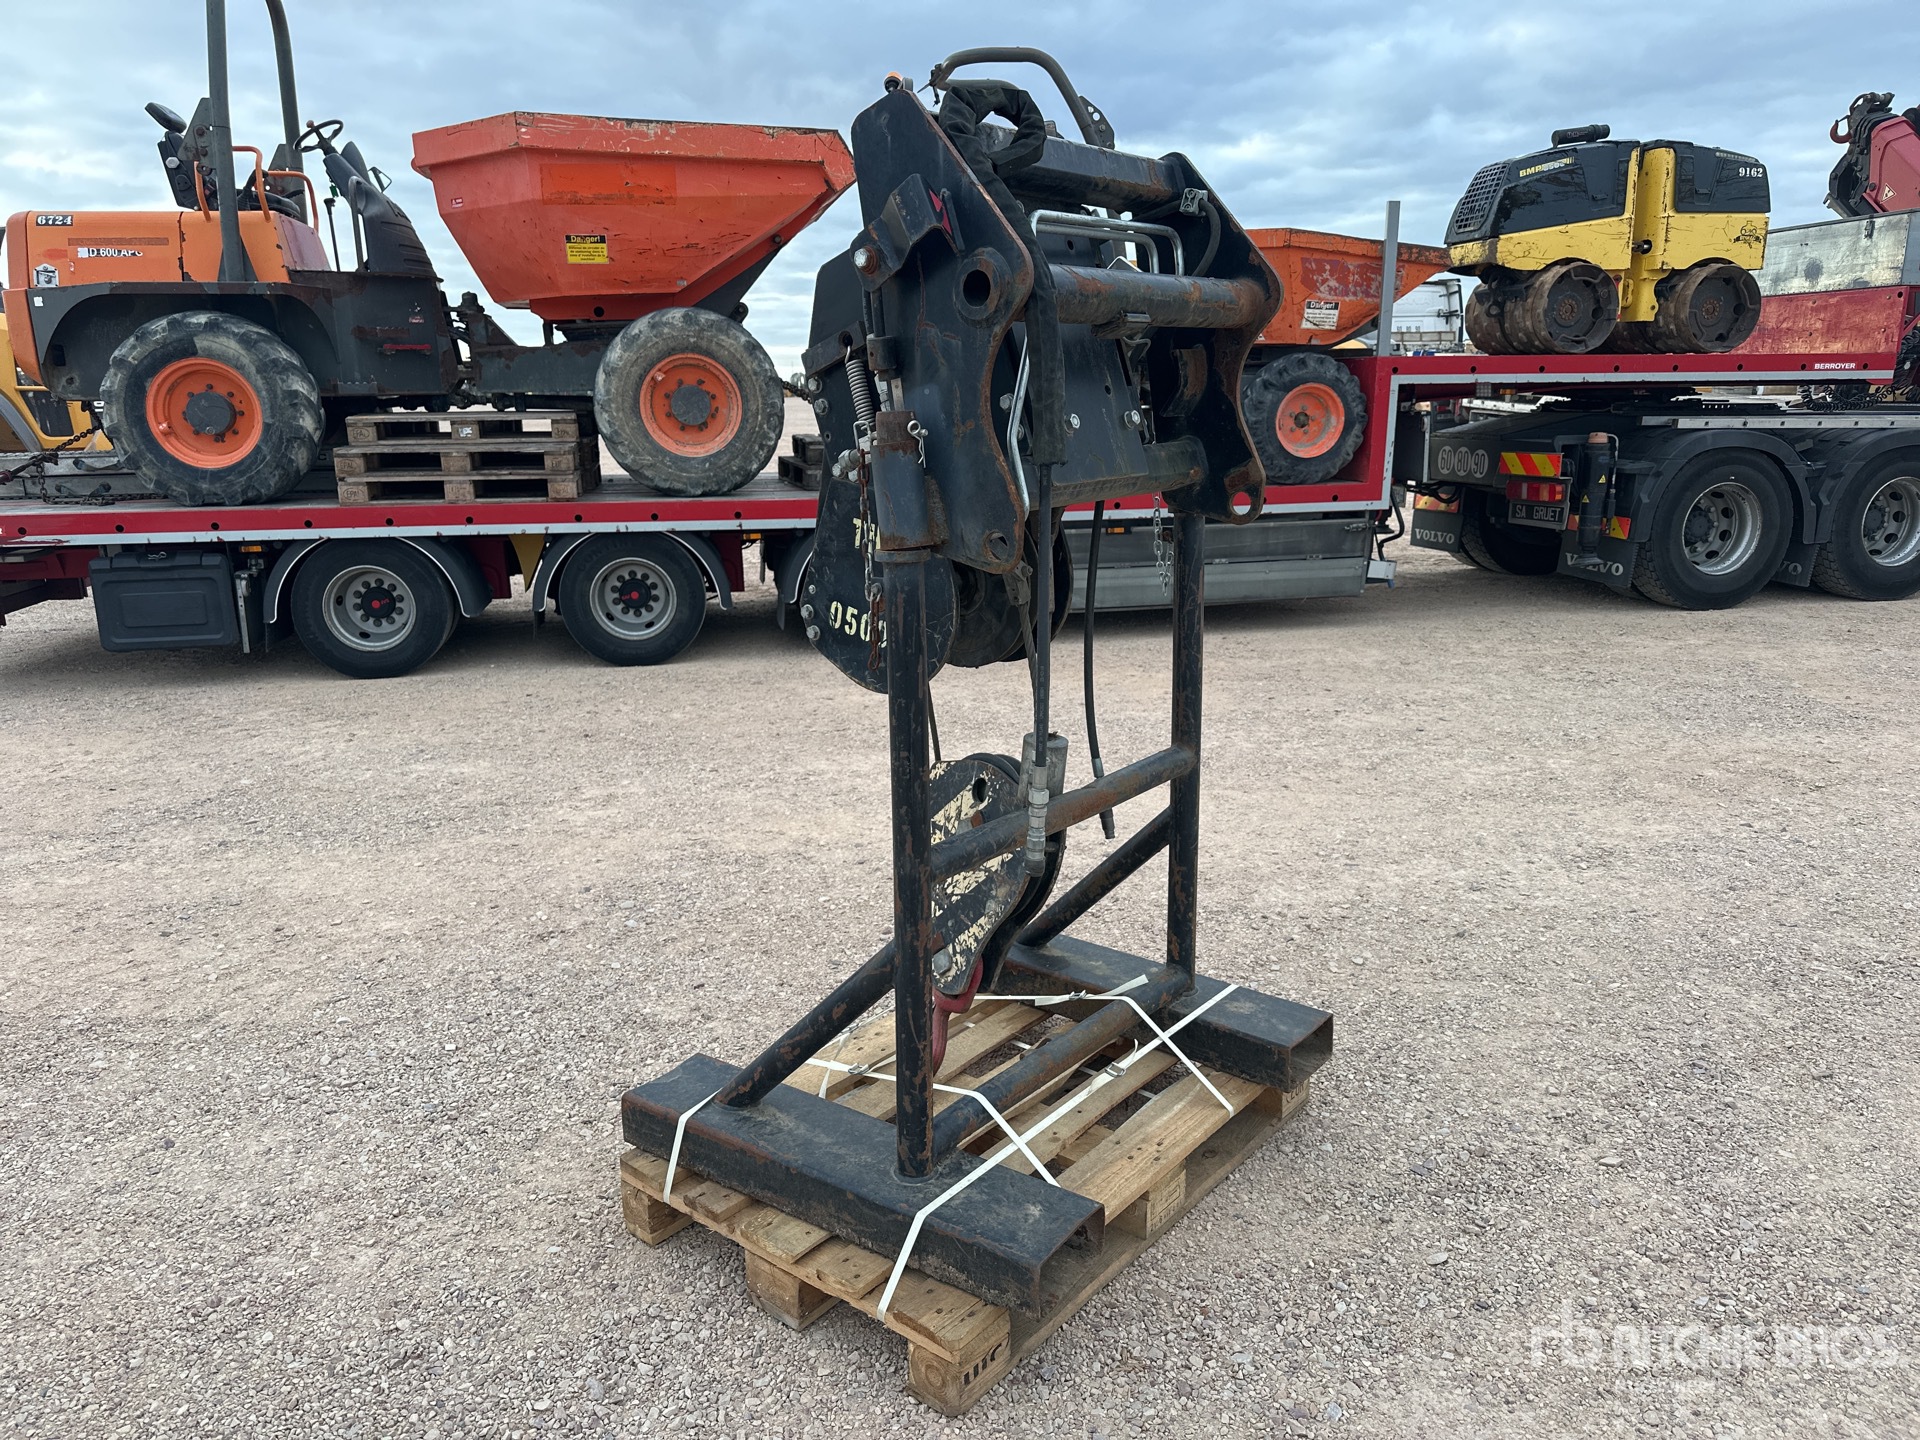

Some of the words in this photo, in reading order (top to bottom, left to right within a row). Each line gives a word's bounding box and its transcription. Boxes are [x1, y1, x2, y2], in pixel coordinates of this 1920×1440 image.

[1738, 167, 1763, 177] 9162
[37, 215, 72, 225] 6724
[89, 248, 97, 257] D
[100, 248, 118, 257] 600
[1814, 362, 1856, 370] BERROYER
[1440, 449, 1451, 471] 60
[1457, 450, 1468, 473] 80
[1473, 452, 1485, 475] 90
[1515, 504, 1526, 518] SA
[1533, 507, 1561, 522] GRUET
[1415, 528, 1455, 544] VOLVO
[1565, 552, 1624, 576] VVO
